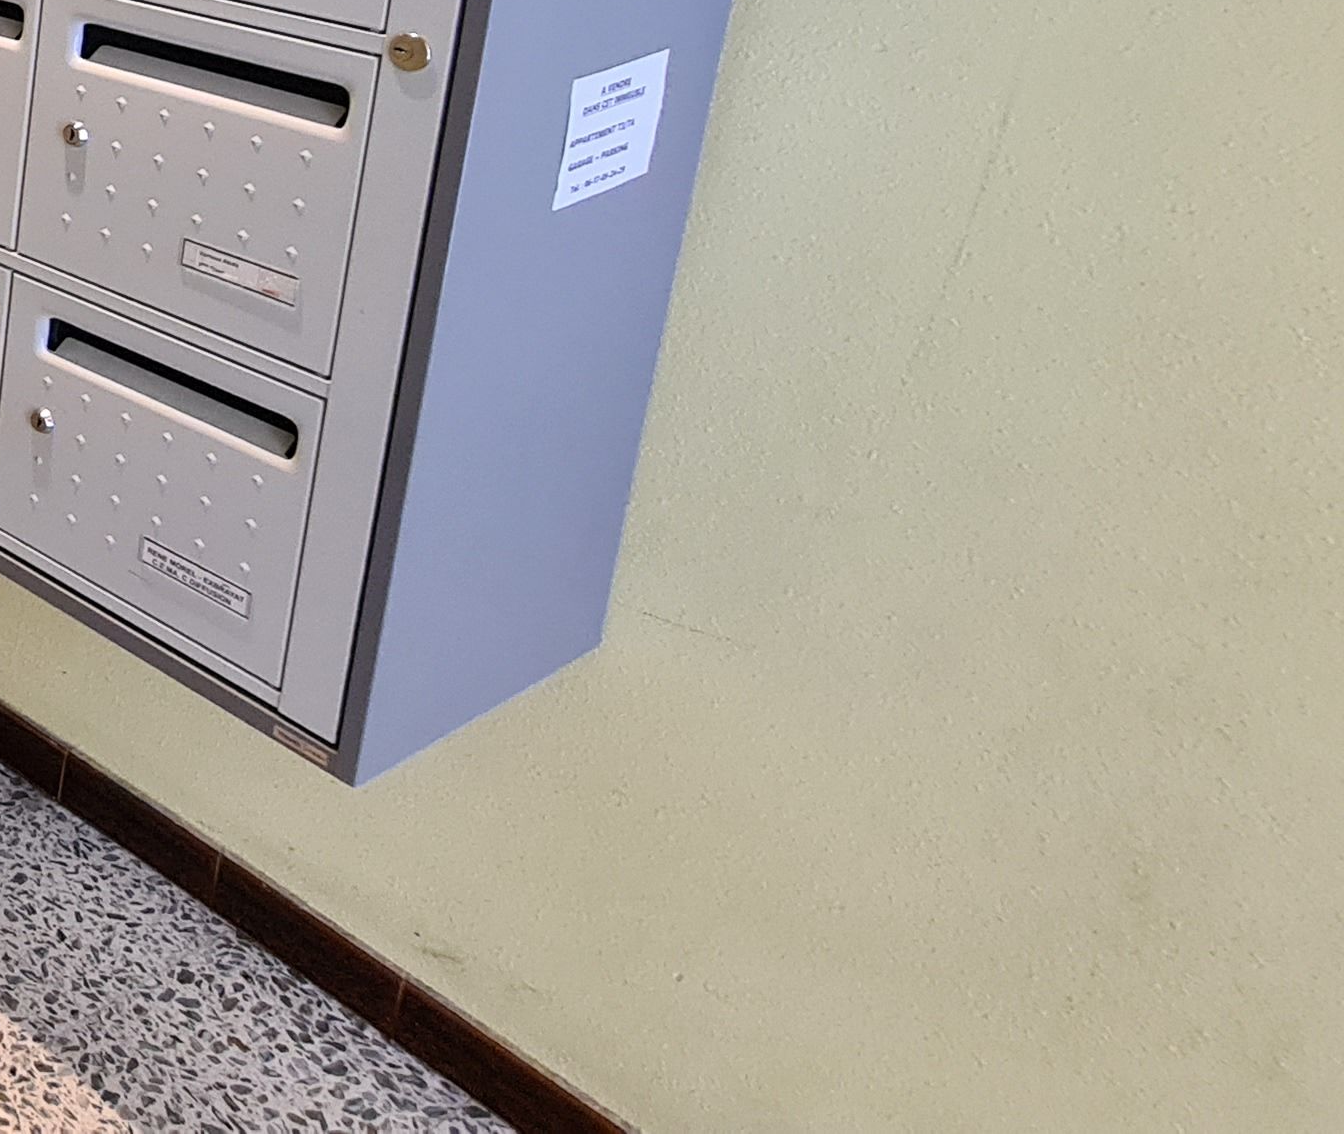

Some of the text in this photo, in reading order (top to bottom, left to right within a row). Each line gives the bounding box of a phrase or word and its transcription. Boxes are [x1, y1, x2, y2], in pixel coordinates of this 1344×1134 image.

[607, 76, 633, 94] VENDRE
[582, 101, 601, 117] DANS
[569, 124, 617, 149] APPARTEMENT
[169, 558, 197, 579] MOREL
